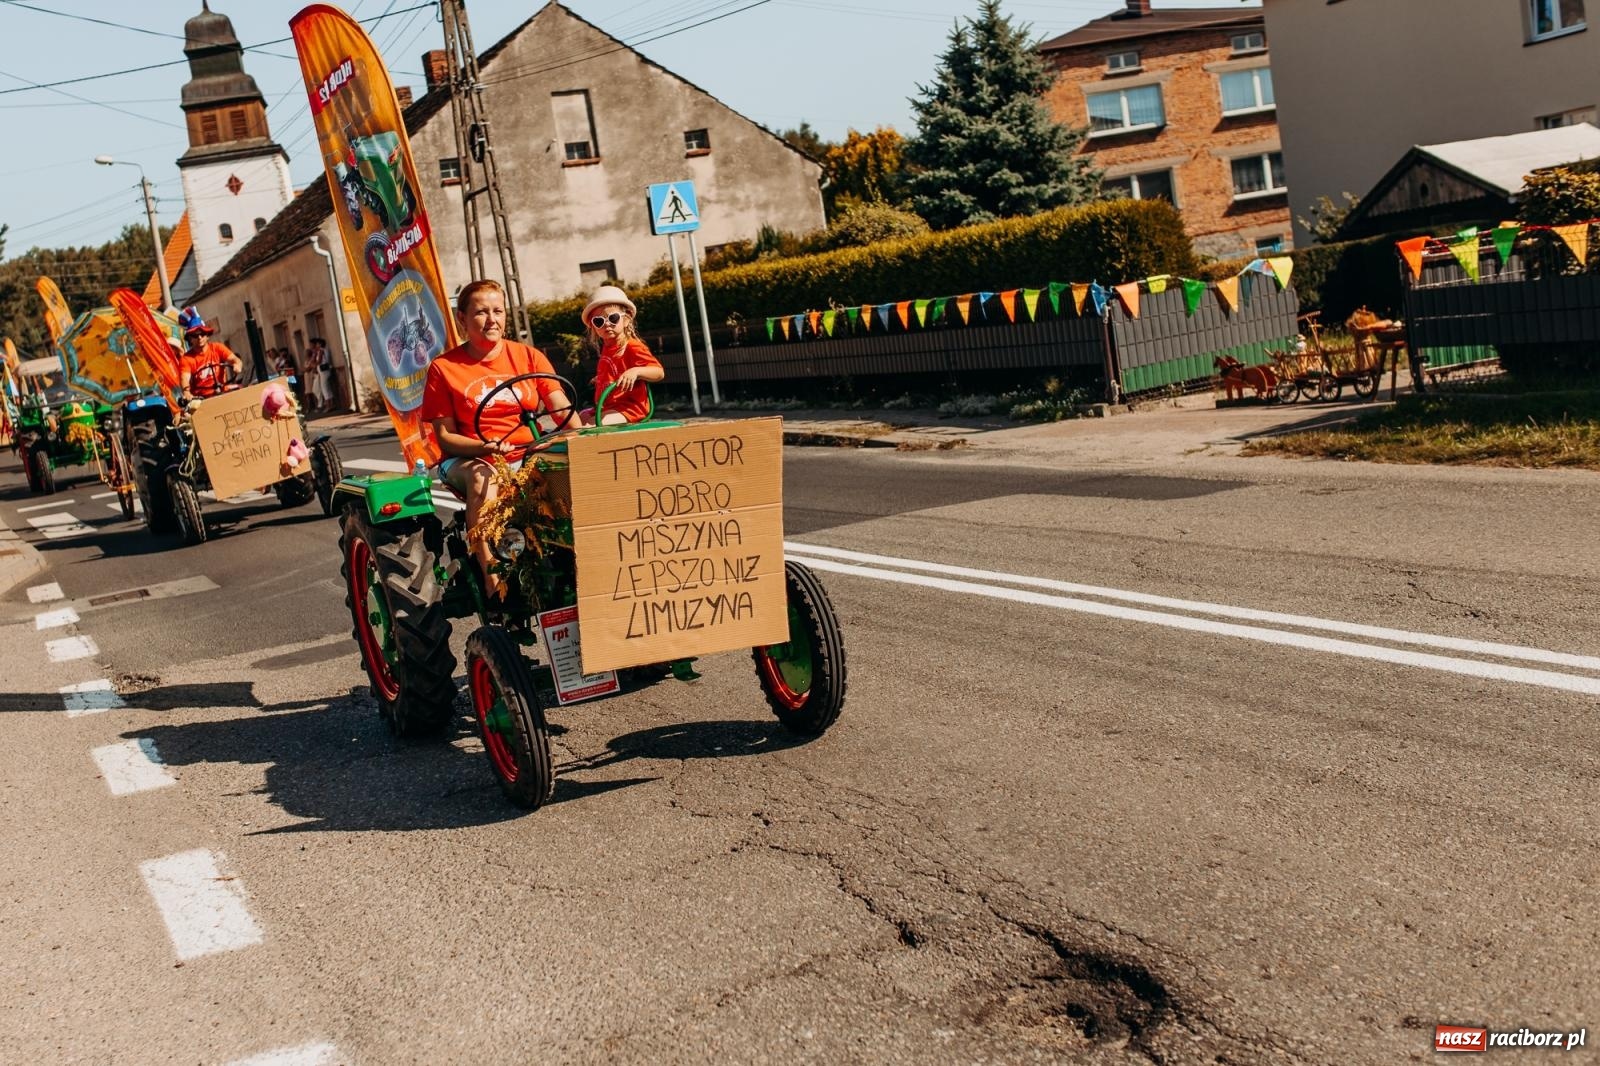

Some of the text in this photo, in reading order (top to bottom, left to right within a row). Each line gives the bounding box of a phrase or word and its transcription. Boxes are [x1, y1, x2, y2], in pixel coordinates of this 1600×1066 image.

[249, 425, 272, 443] DO
[231, 443, 272, 468] SIANA
[598, 435, 744, 481] TRAKTOR
[636, 480, 731, 519] DOBRO
[617, 519, 742, 562] MASZYNA
[612, 558, 715, 601] LEPSZO
[552, 627, 569, 642] rpt
[625, 592, 754, 639] LIMUZYNA
